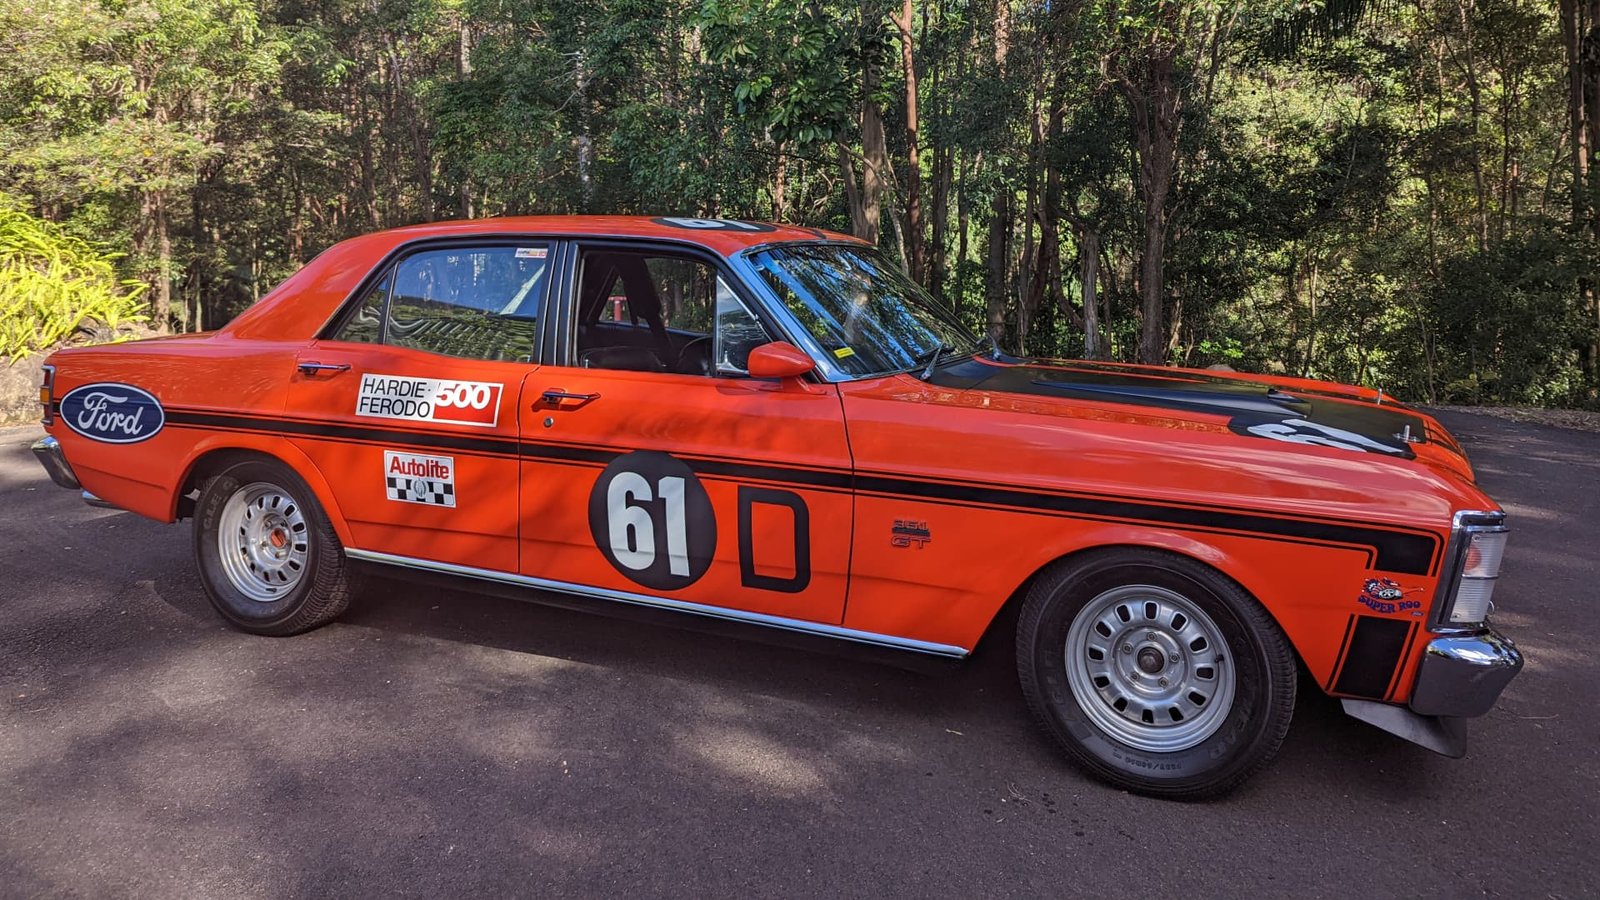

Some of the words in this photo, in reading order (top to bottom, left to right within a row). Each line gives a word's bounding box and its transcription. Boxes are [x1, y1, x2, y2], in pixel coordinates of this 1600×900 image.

[663, 217, 760, 230] 61
[359, 397, 430, 418] FERODO
[435, 384, 491, 410] 500
[78, 392, 144, 435] Ford
[390, 456, 450, 479] Autolite
[607, 472, 690, 577] 61
[737, 485, 812, 594] D
[891, 535, 931, 549] GT
[1359, 595, 1395, 613] SUPER
[1399, 601, 1420, 610] ROO
